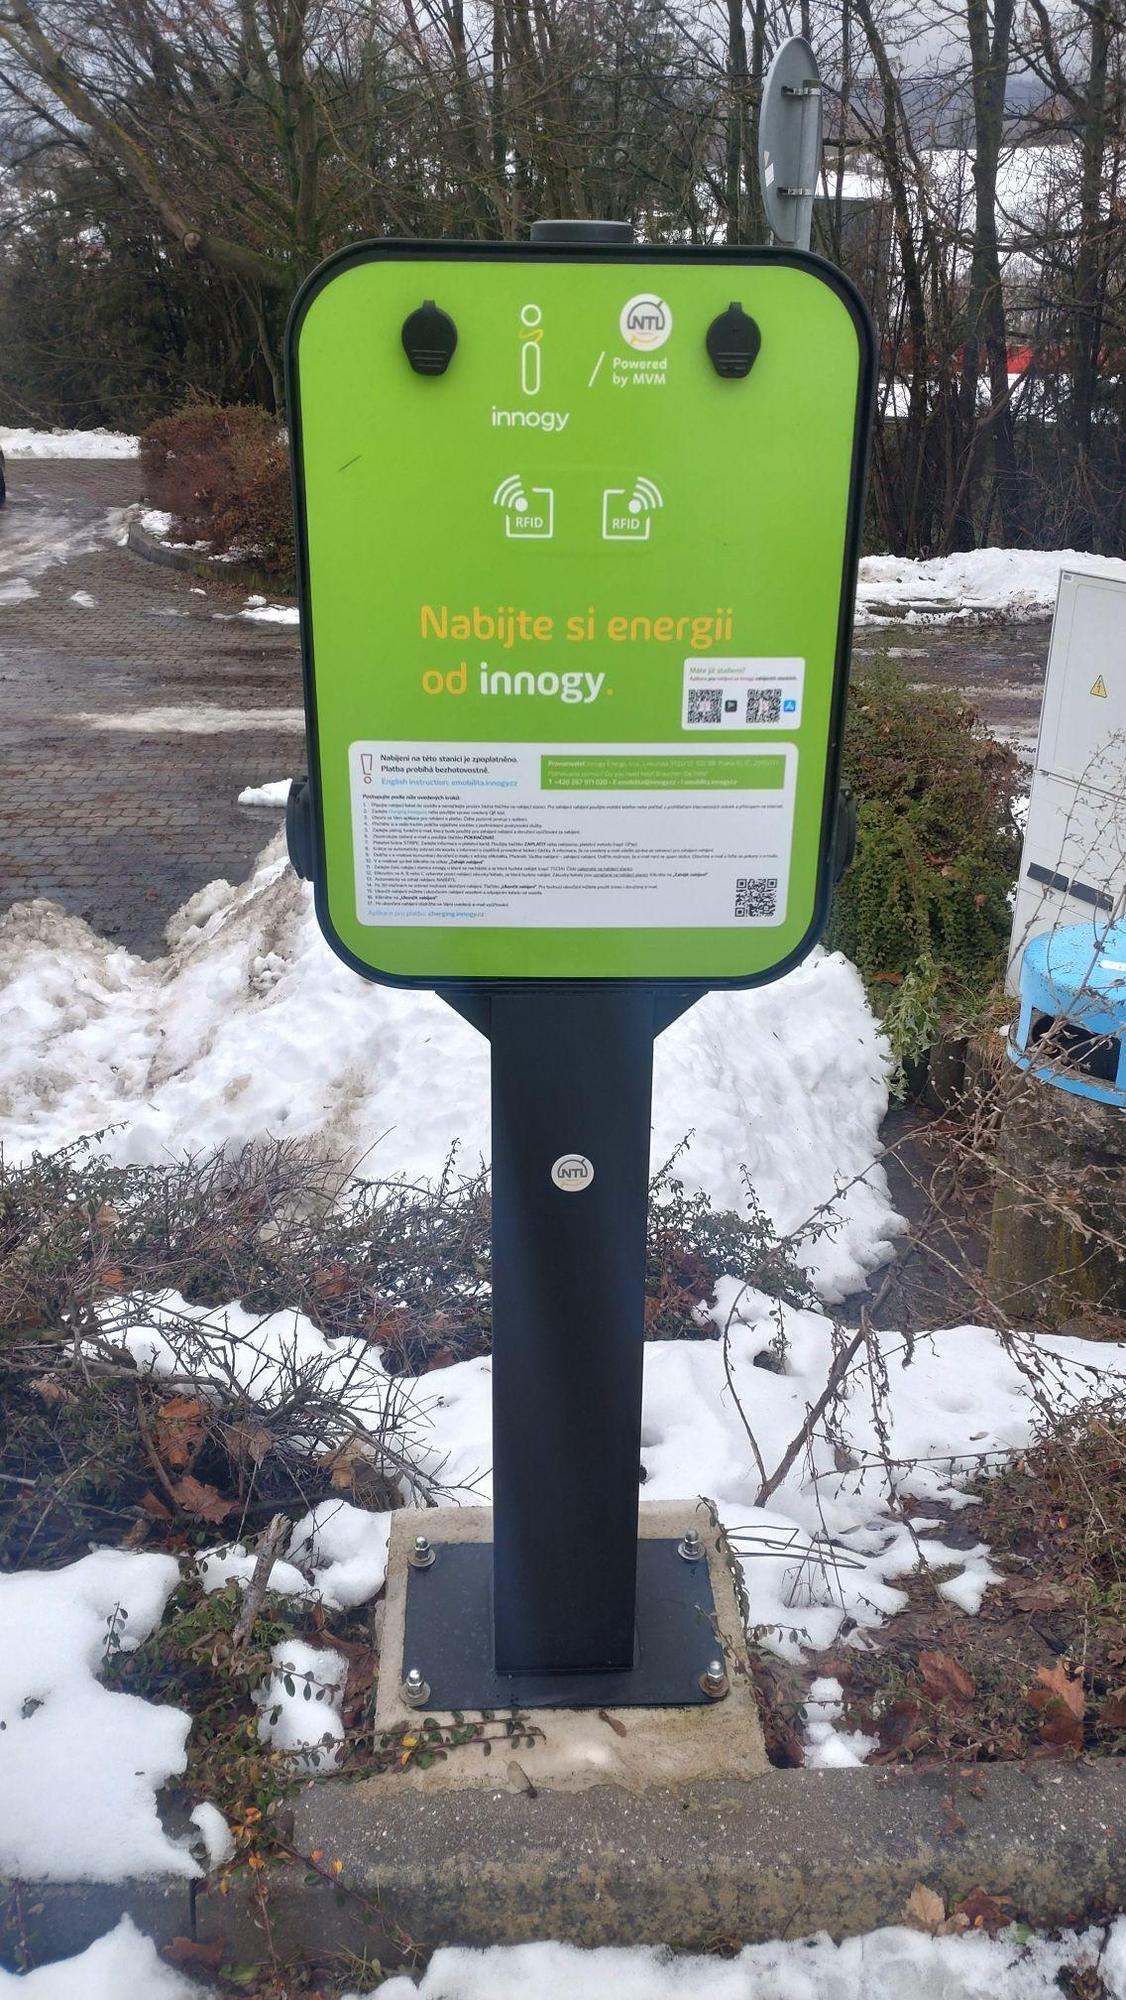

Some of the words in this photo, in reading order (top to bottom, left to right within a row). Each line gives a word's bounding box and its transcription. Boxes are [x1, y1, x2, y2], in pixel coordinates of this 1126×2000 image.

[612, 357, 667, 370] Powered
[612, 373, 628, 388] by
[632, 374, 666, 385] MVM
[491, 405, 570, 432] innogy
[515, 516, 544, 528] RFID
[612, 518, 641, 530] RFID
[420, 605, 553, 649] Nabijte
[566, 607, 596, 641] si
[607, 608, 733, 650] energii
[421, 661, 467, 695] od
[479, 661, 614, 704] innogy.
[422, 755, 438, 763] této
[439, 755, 463, 764] stanici
[463, 755, 471, 765] je
[381, 764, 405, 773] Platba
[406, 765, 434, 775] probíhá
[381, 778, 409, 787] English
